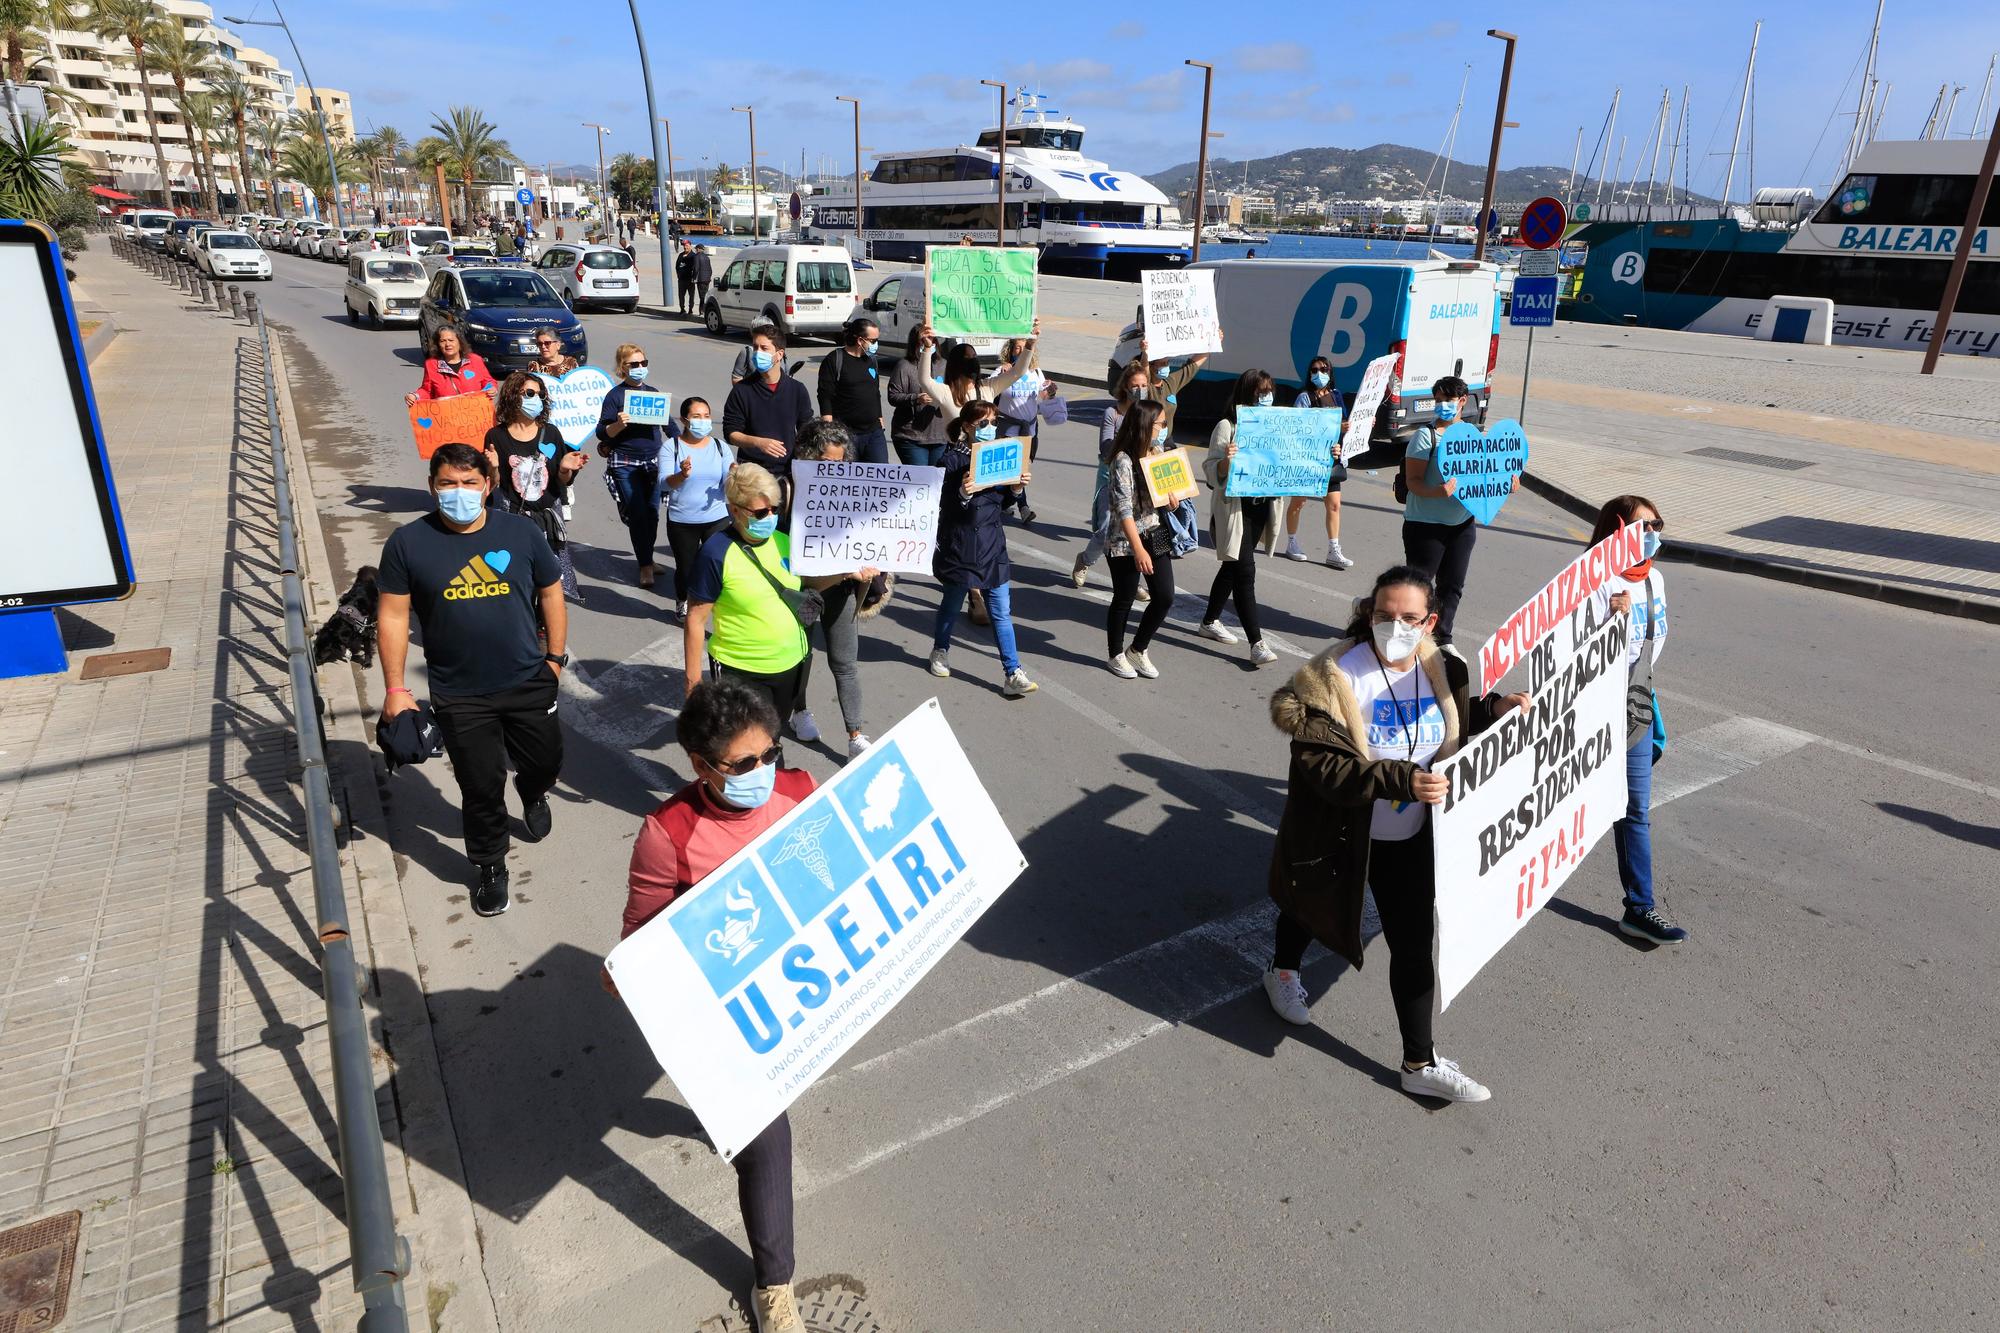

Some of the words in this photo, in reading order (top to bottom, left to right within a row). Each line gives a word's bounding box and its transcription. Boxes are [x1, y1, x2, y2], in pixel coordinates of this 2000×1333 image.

[1025, 178, 1030, 188] 9
[1839, 227, 1988, 253] BALEARA
[936, 251, 971, 272] IBIZA
[983, 253, 1003, 272] SE
[1621, 256, 1637, 277] B
[948, 274, 998, 295] QUEDA
[1007, 276, 1034, 295] SIN
[1516, 294, 1553, 309] TAXI
[1317, 282, 1372, 368] B
[416, 401, 441, 416] NO
[421, 430, 453, 443] NOS
[1264, 426, 1312, 435] SANIDAD
[1280, 451, 1319, 461] SALARIAL
[1504, 458, 1523, 472] CON
[808, 484, 906, 499] FORMENTERA
[1252, 479, 1268, 487] POR
[804, 516, 854, 529] CEUTA
[443, 582, 510, 600] adidas
[1480, 514, 1643, 700] ACTUALIZACIÓN
[1531, 631, 1556, 698] DE
[1571, 597, 1602, 652] LA
[1443, 612, 1630, 814] INDEMNIZACIÓN
[1533, 708, 1576, 786] POR
[1478, 722, 1612, 877] RESIDENCIA
[724, 816, 967, 1055] U.S.E.I.R.I
[766, 1046, 804, 1081] UNIÓN
[803, 1030, 820, 1048] DE
[819, 977, 876, 1034] SANITARIOS
[875, 959, 896, 982] POR
[896, 948, 908, 962] LA
[907, 888, 966, 951] EQUIPARACIÓN
[964, 877, 978, 893] DE
[794, 1008, 871, 1088] INDEMNIZACIÓN
[870, 988, 894, 1013] POR
[894, 977, 908, 993] LA
[903, 928, 953, 980] RESIDENCIA
[950, 917, 964, 932] EN
[963, 896, 984, 919] IBIZA
